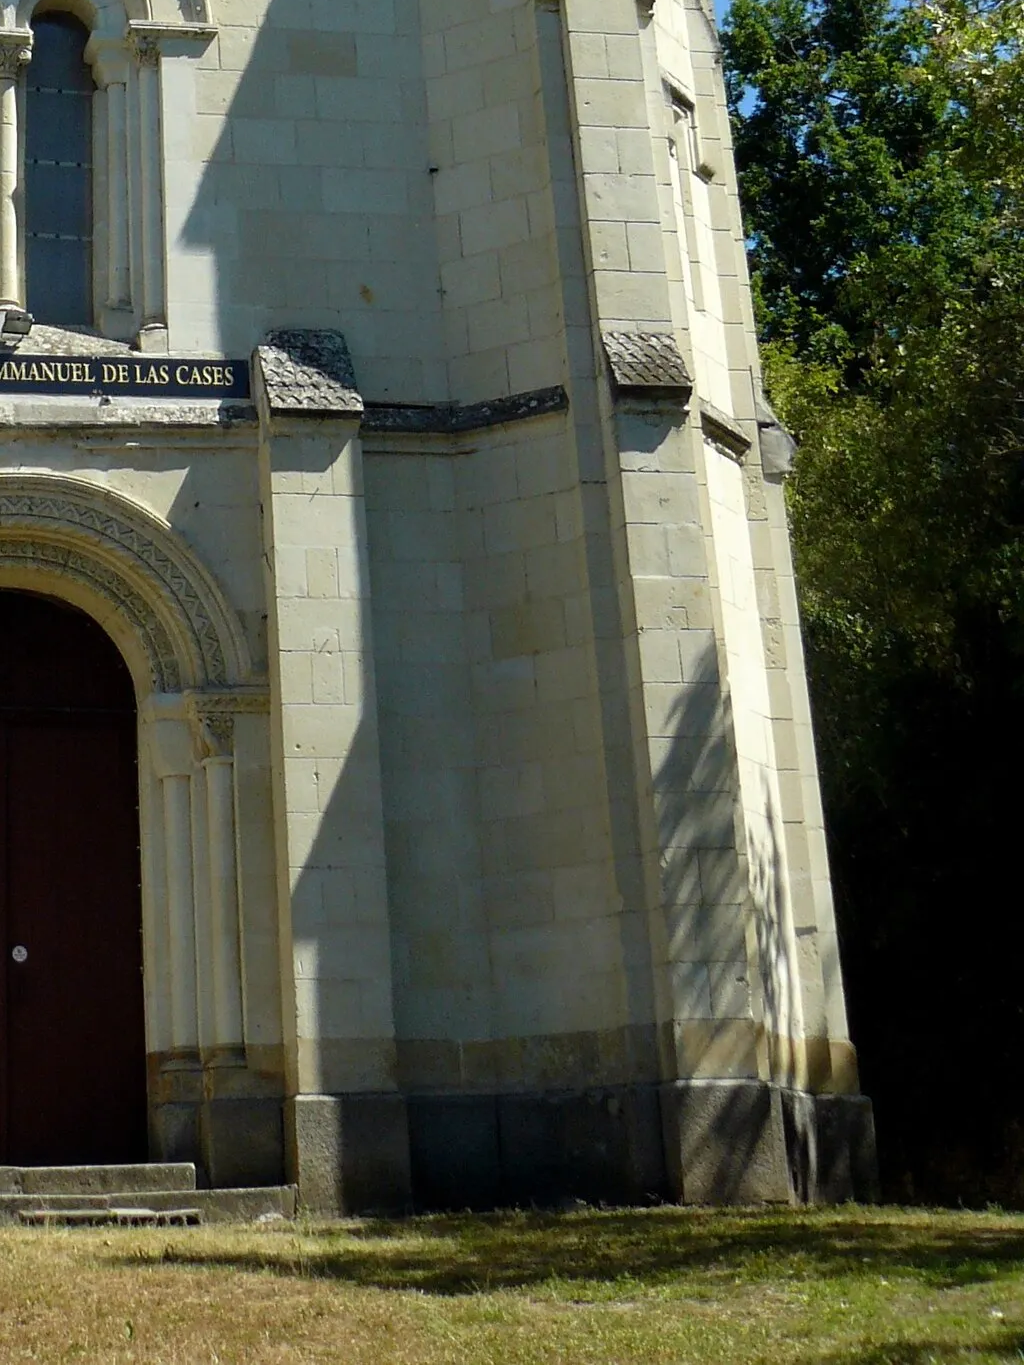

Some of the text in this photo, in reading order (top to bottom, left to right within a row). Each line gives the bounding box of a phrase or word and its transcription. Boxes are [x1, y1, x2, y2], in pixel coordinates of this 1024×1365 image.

[102, 363, 130, 383] DE
[135, 364, 169, 385] LAS
[175, 365, 234, 386] CASES
